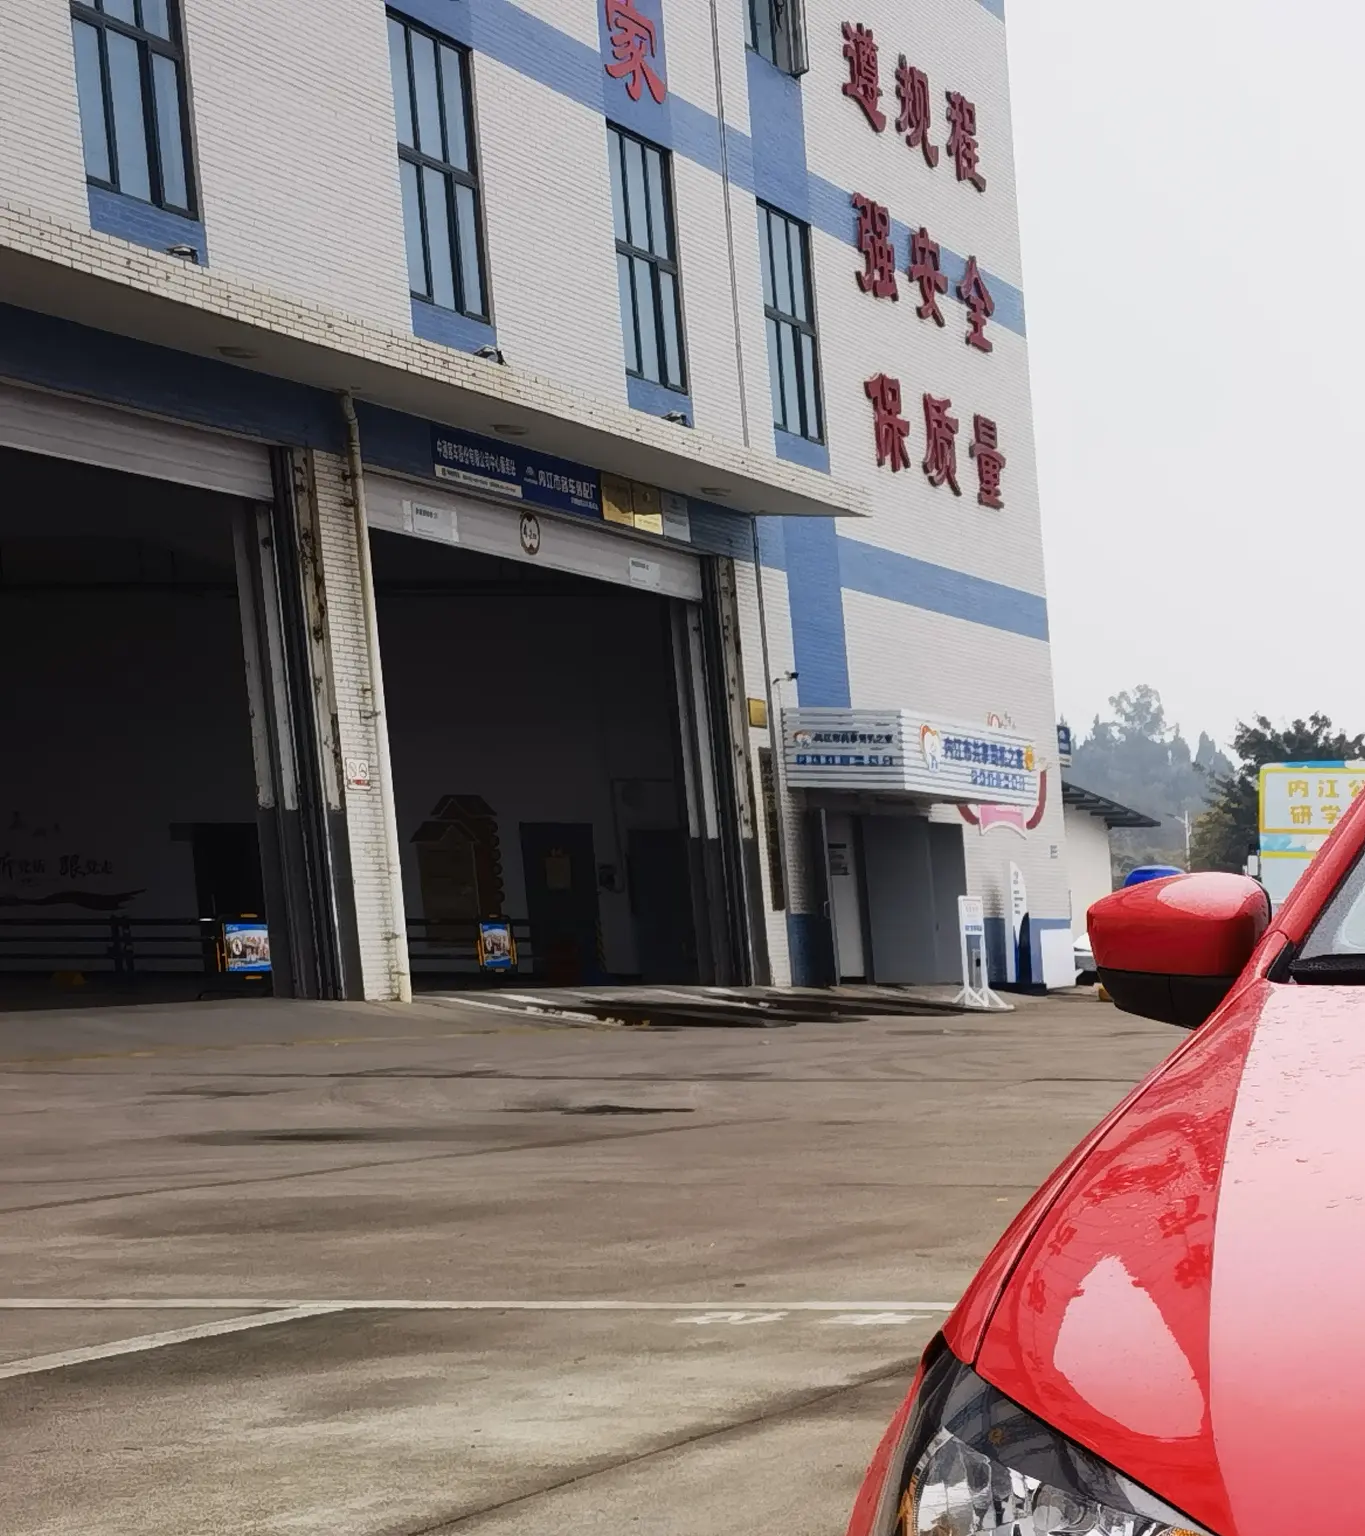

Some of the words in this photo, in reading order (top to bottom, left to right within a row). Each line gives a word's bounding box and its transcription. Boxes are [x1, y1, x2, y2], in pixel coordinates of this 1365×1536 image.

[604, 0, 667, 104] 家
[841, 21, 986, 192] 遵规程
[851, 191, 994, 352] 强安全
[864, 373, 1006, 509] 保质量
